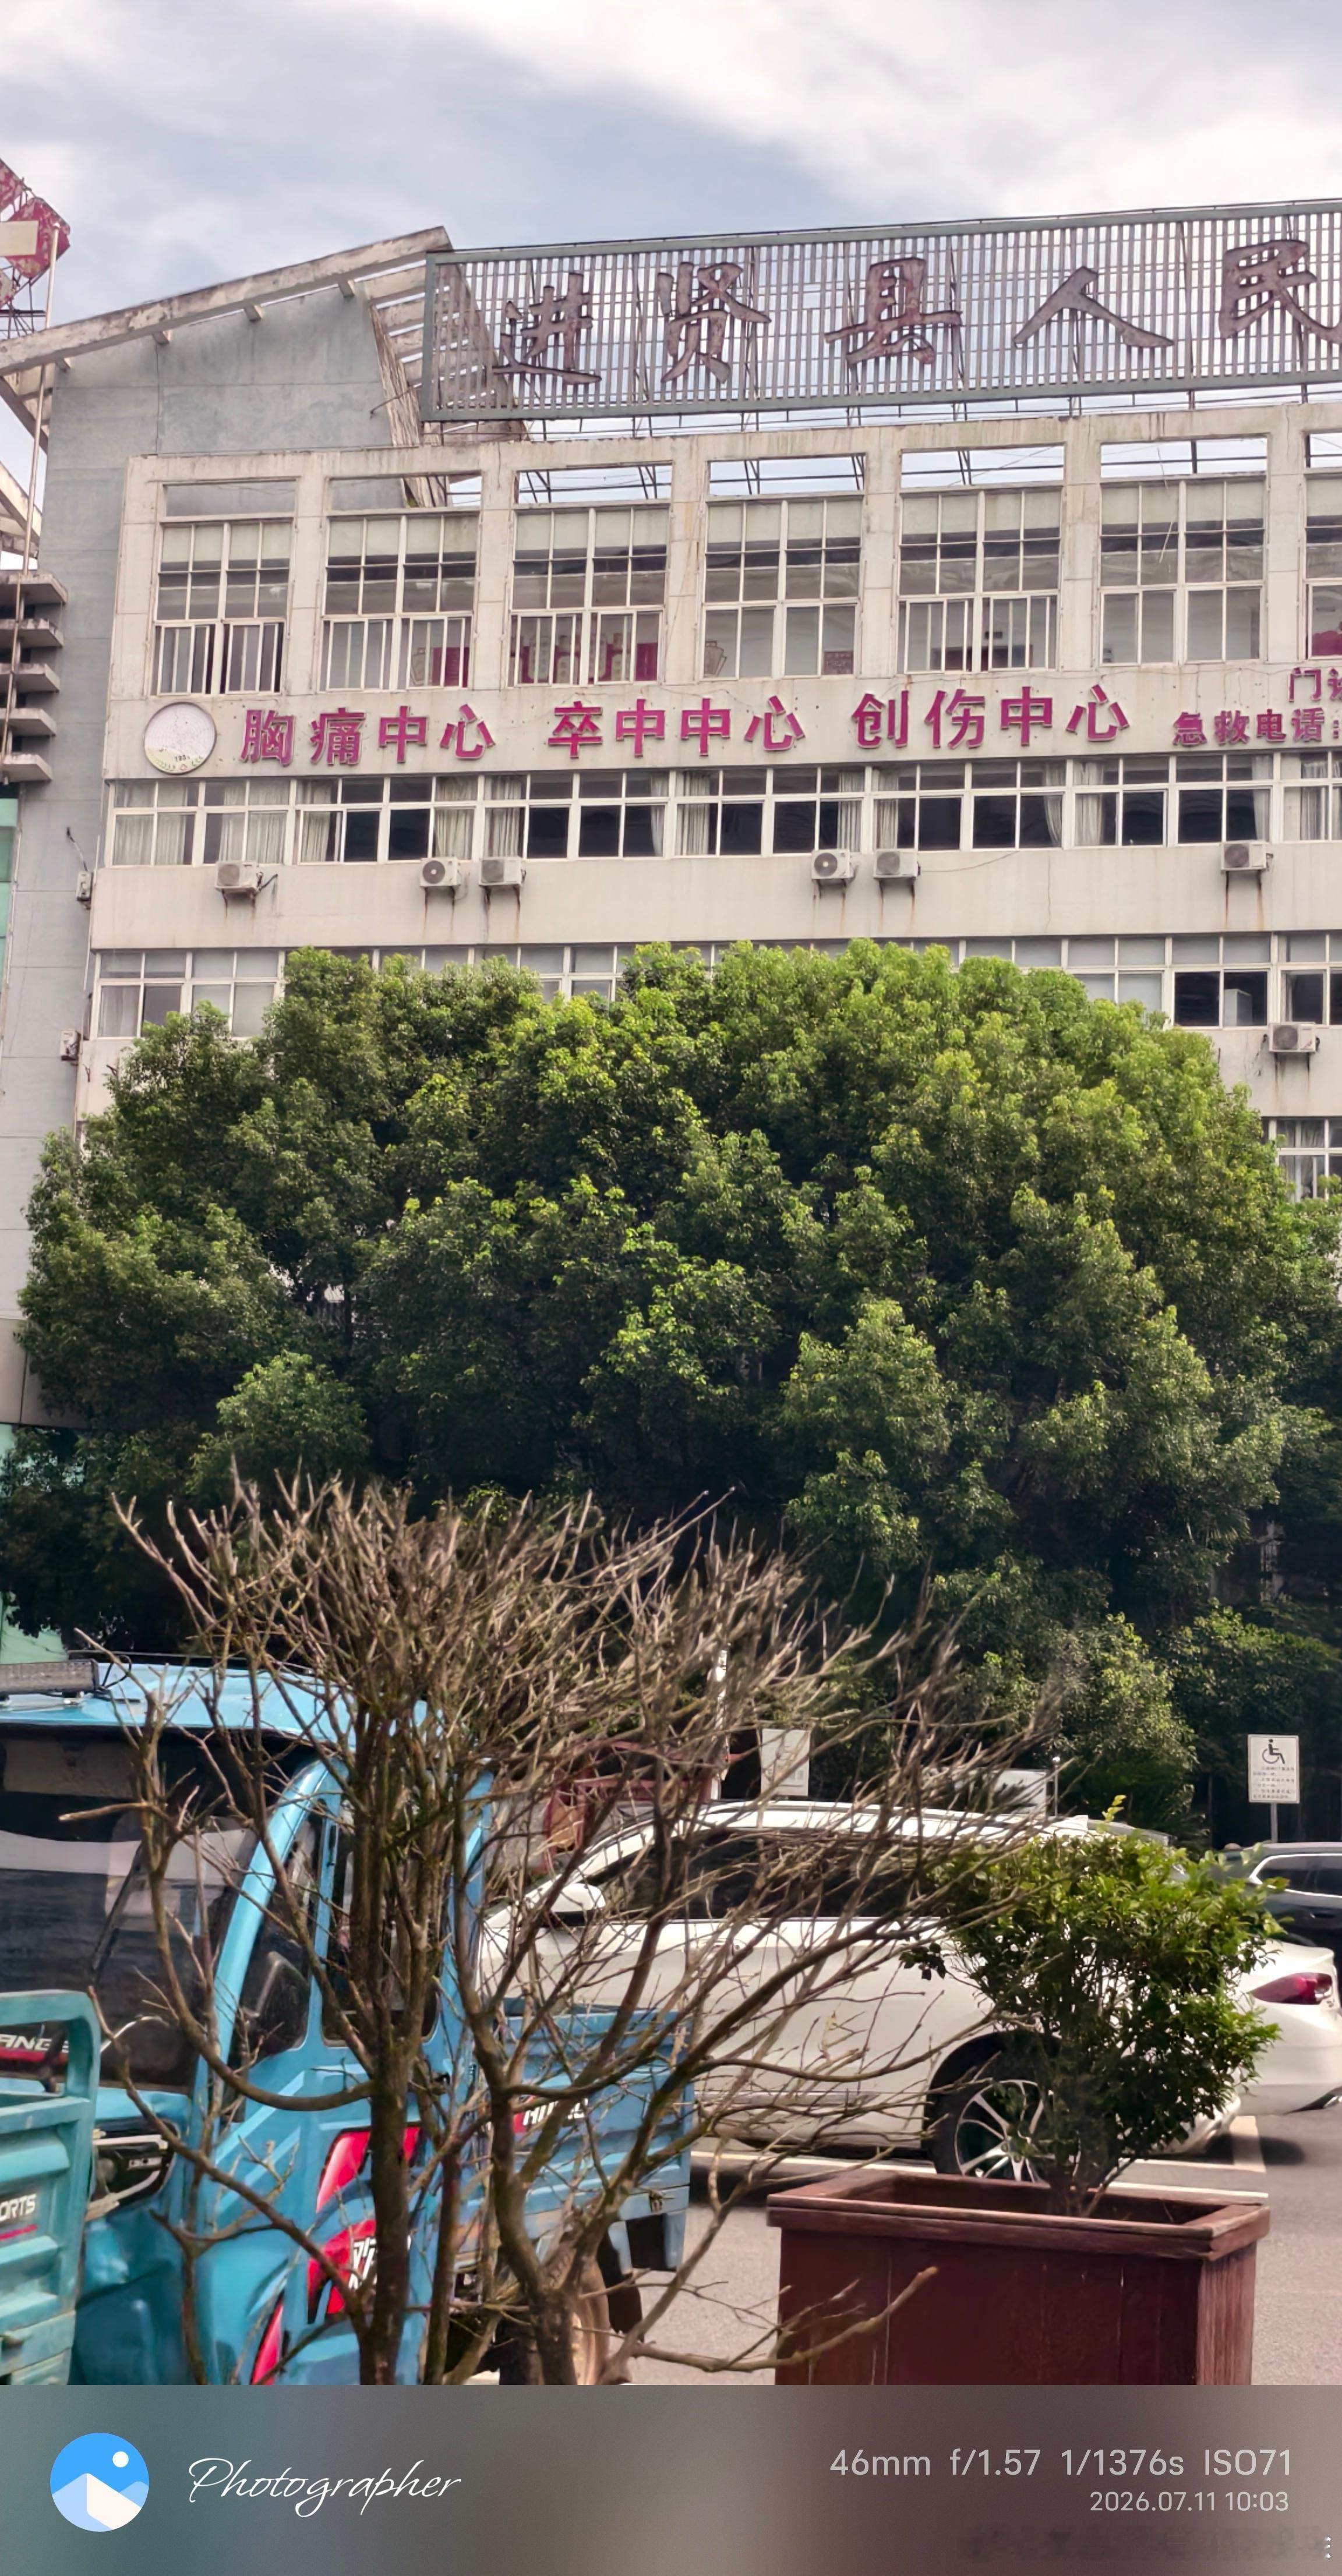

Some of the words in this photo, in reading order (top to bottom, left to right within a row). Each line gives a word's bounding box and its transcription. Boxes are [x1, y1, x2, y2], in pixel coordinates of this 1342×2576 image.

[492, 239, 1342, 385] 进贤县人民
[239, 703, 496, 767] 胸痛中心
[547, 694, 806, 759] 卒中中心
[851, 684, 1130, 749] 创伤中心
